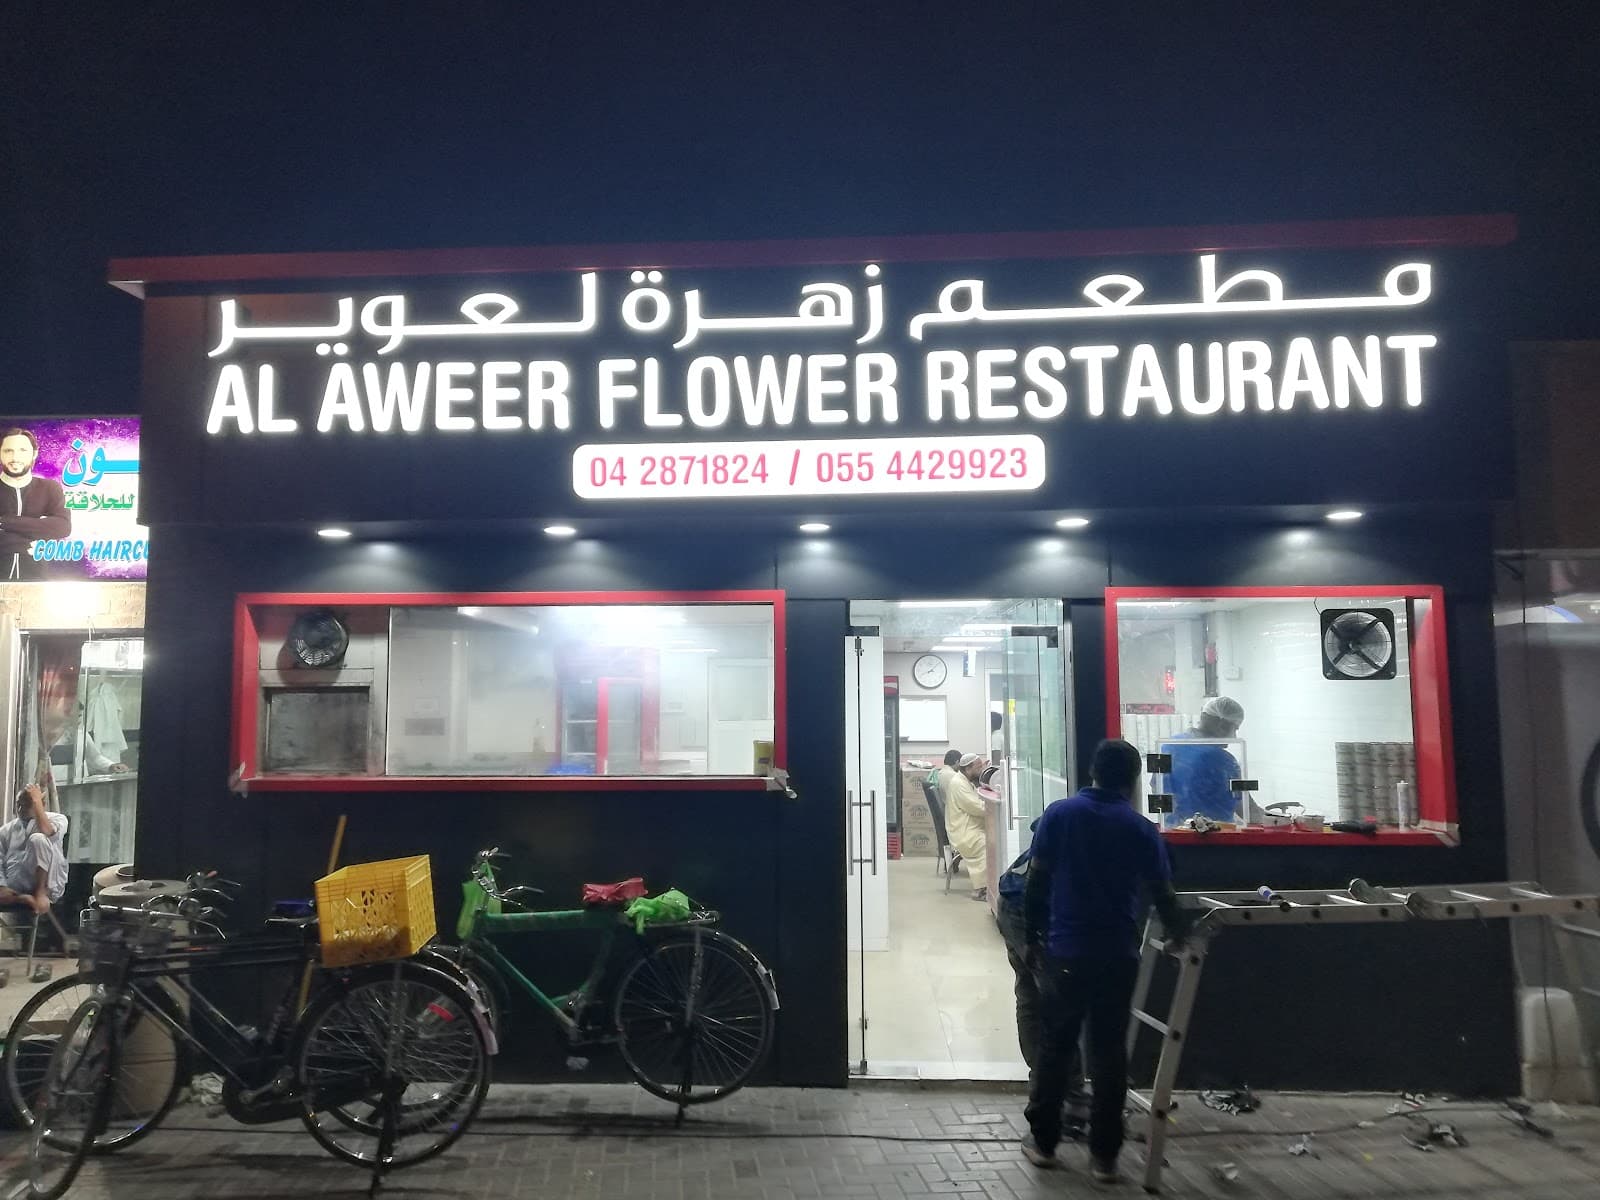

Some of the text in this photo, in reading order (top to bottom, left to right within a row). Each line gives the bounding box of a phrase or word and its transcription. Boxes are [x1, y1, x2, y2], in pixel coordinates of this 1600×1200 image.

[207, 254, 1432, 357] مطعم زهرة لعوير
[206, 334, 1437, 434] AL AWEER FLOWER RESTAURANT
[590, 447, 1028, 487] 04 2871824 / 055 4429923
[64, 491, 135, 512] للحلاقة
[33, 540, 84, 561] COMB
